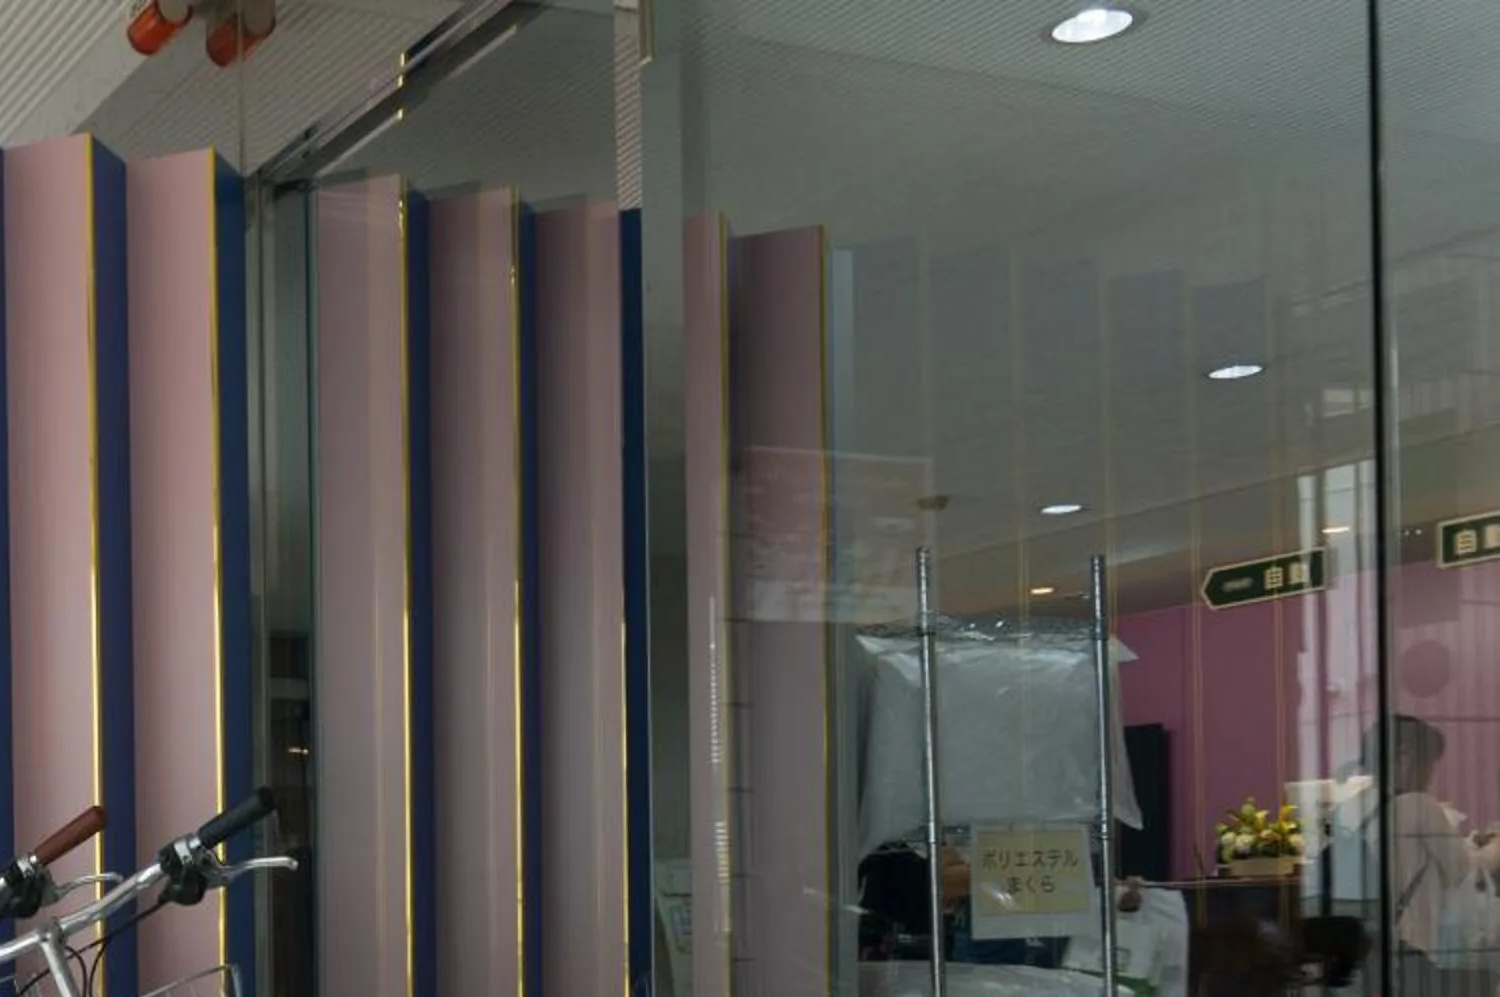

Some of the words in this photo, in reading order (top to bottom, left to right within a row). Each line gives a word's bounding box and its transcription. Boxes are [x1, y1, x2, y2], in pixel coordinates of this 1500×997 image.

[982, 848, 1079, 871] ポリエステル
[1007, 874, 1056, 895] まくら
